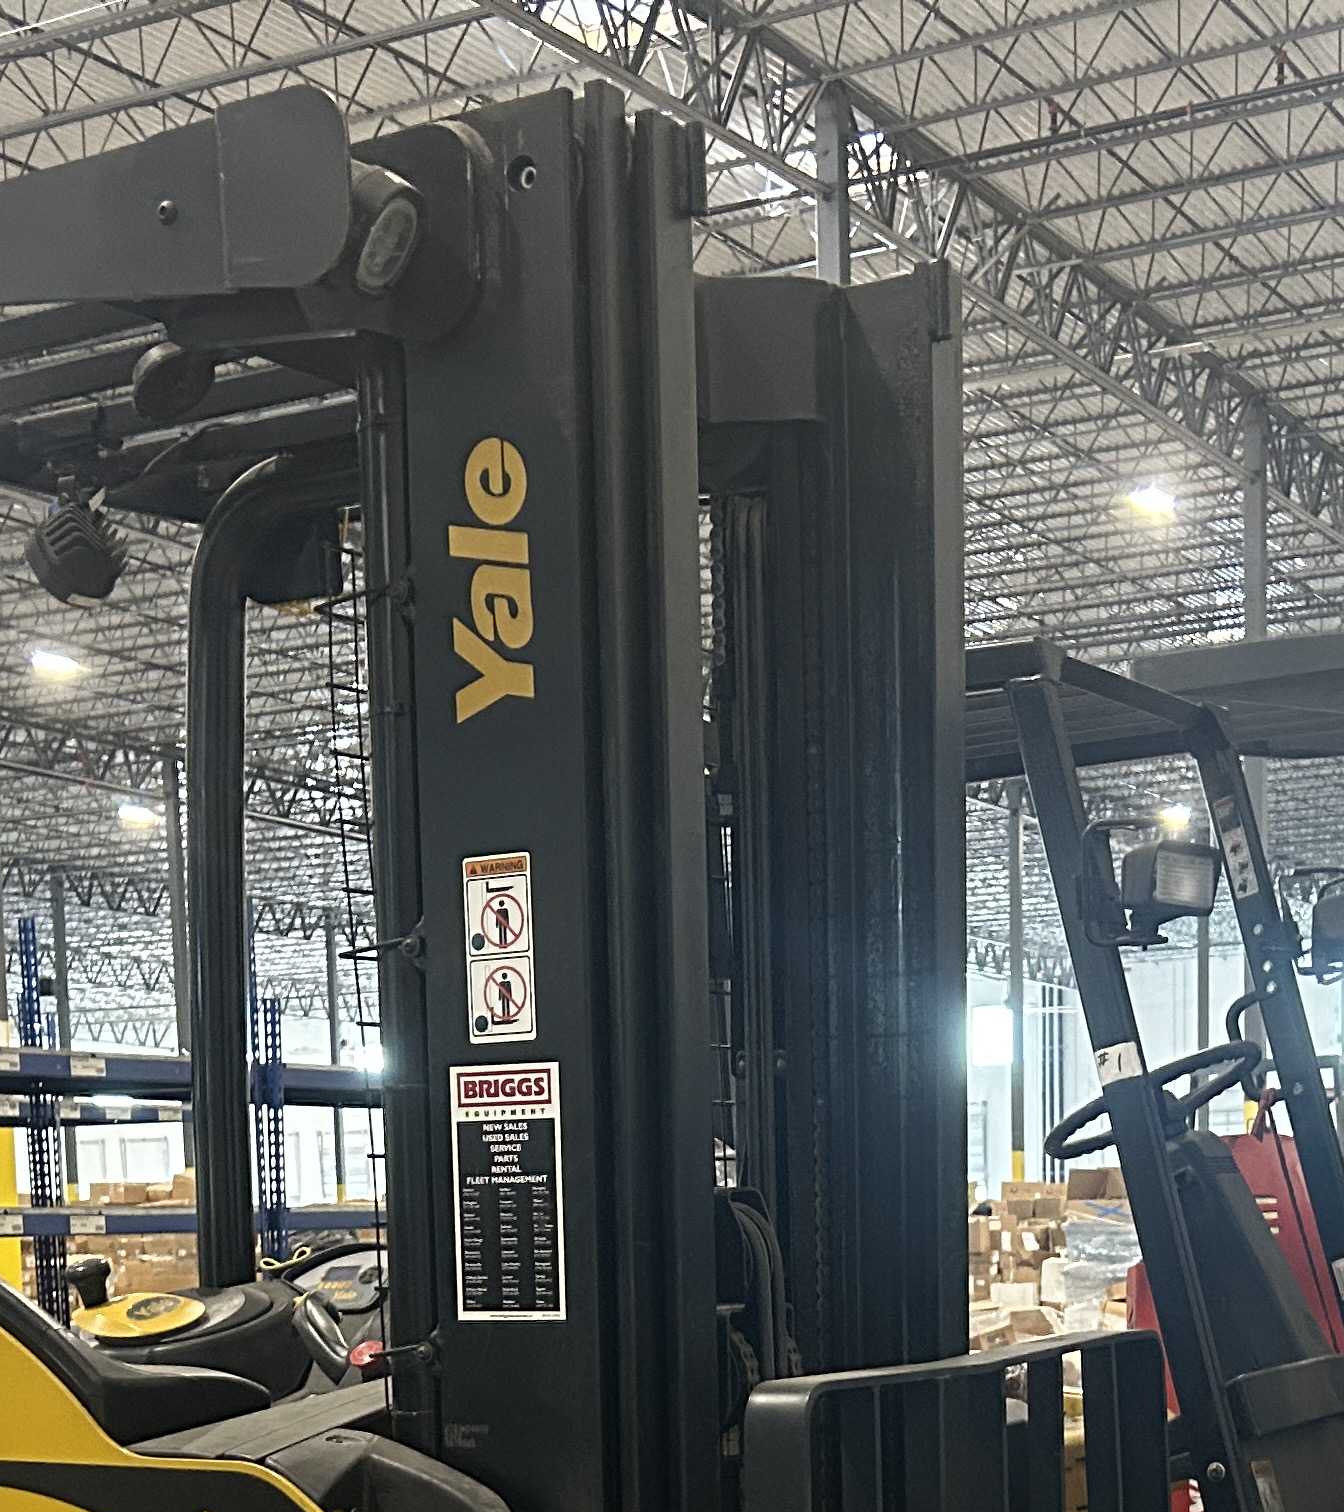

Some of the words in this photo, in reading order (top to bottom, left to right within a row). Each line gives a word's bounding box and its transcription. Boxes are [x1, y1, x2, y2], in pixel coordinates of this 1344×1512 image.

[448, 436, 535, 724] Yale
[480, 860, 524, 873] WARNING
[463, 1077, 545, 1098] BRIGGS
[465, 1108, 546, 1117] EQUIPMENT
[482, 1123, 502, 1131] NEW
[504, 1122, 528, 1130] SALES
[482, 1134, 503, 1142] USED
[504, 1133, 529, 1141] SALES
[490, 1144, 522, 1152] SERVICE
[494, 1155, 519, 1163] PARTS
[491, 1165, 522, 1173] RENTAL
[491, 1175, 548, 1184] MANAGEMENT
